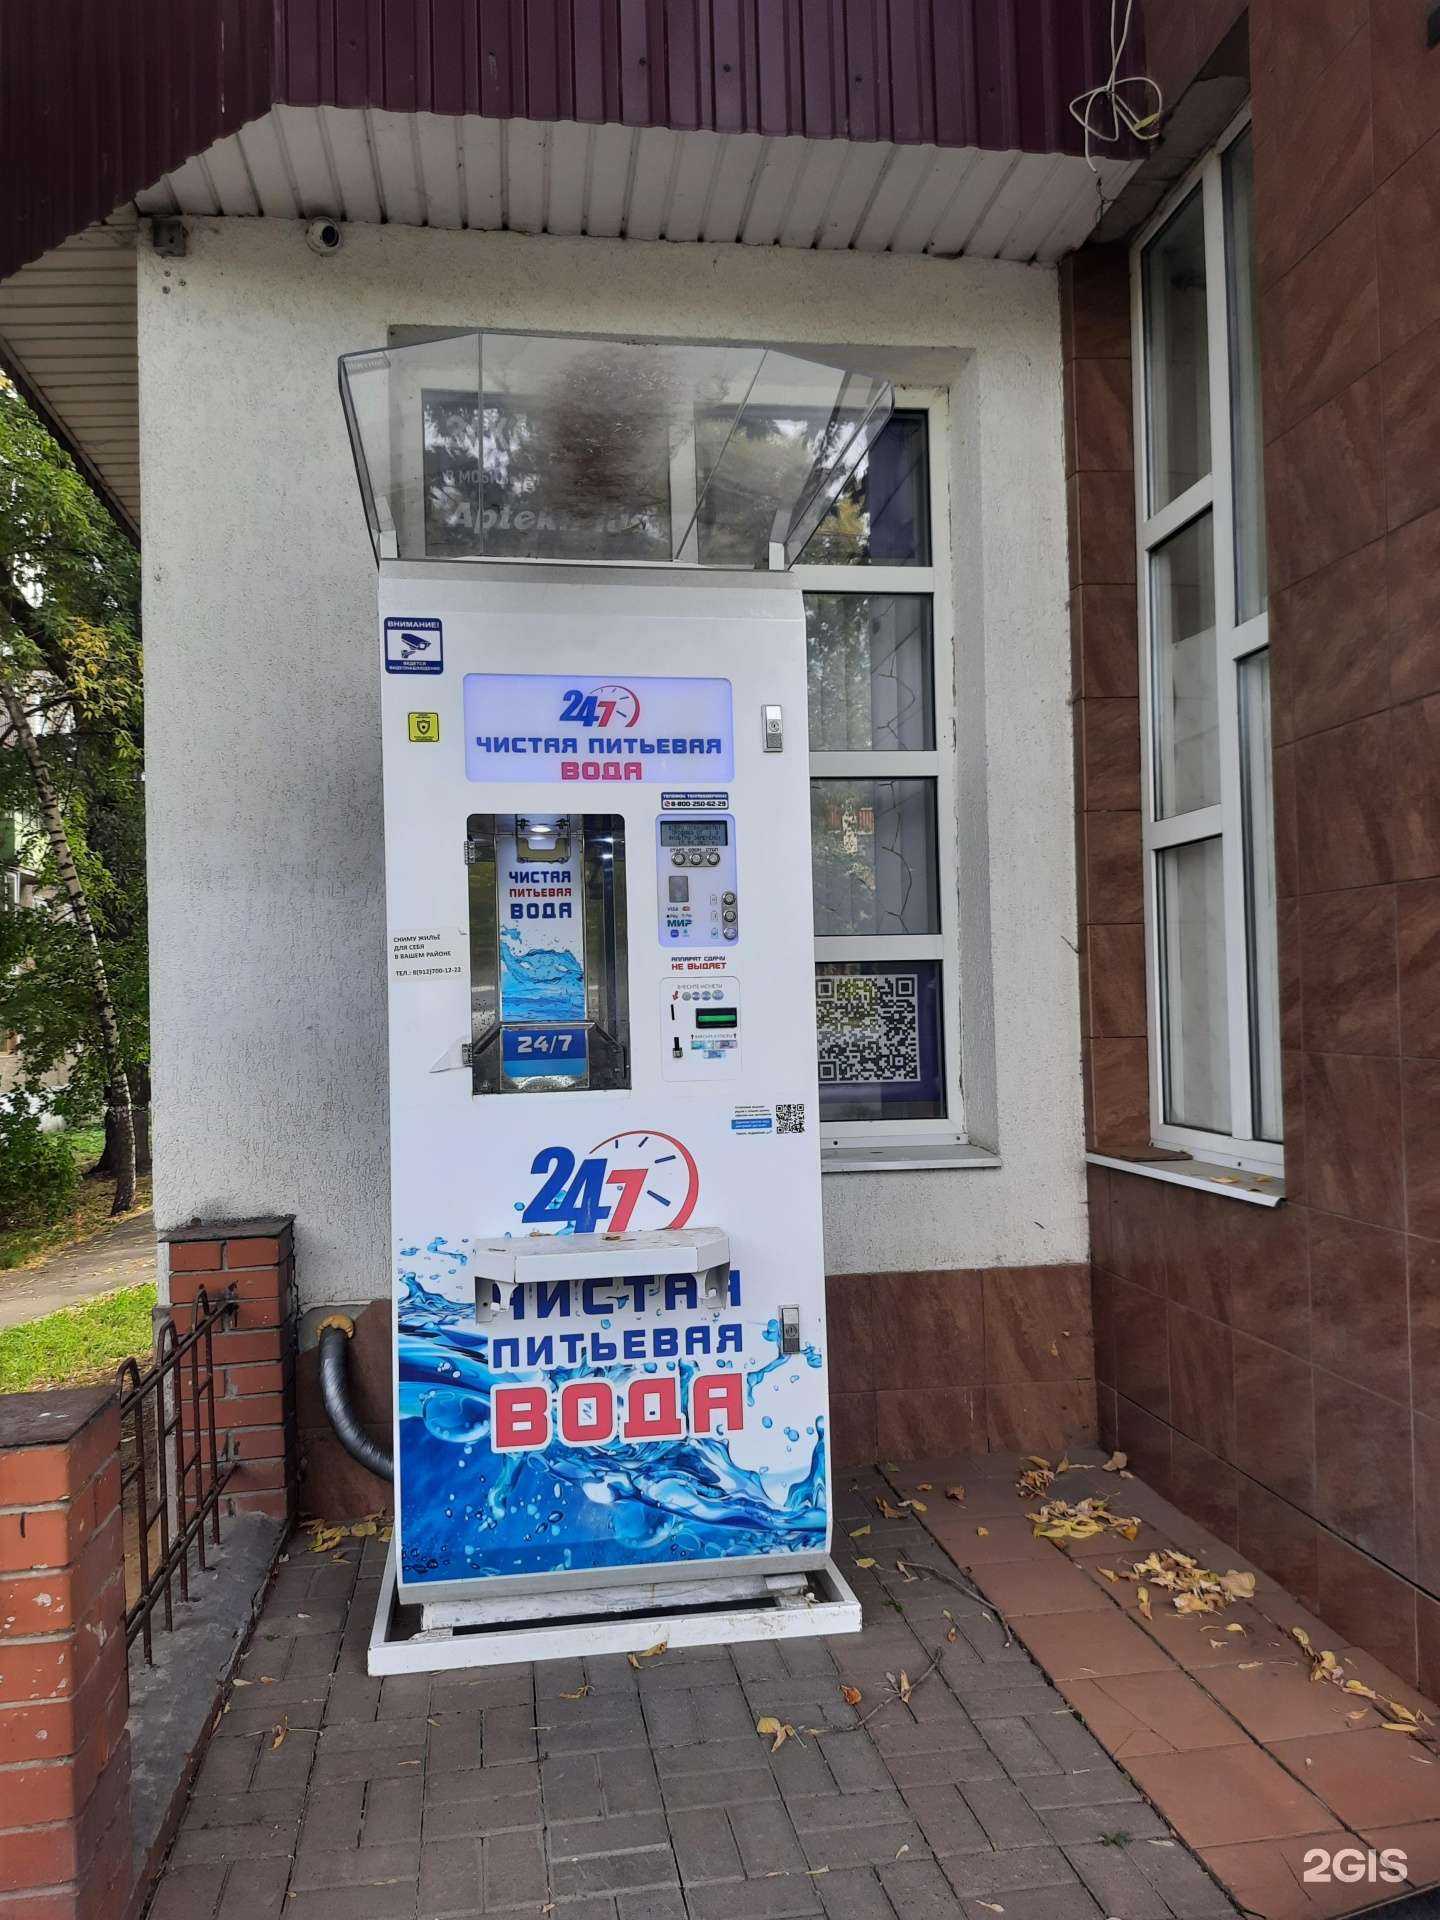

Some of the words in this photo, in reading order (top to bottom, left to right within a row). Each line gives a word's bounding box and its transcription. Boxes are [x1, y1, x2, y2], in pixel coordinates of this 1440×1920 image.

[387, 620, 440, 629] ВНИМАНИЕ!
[476, 736, 578, 754] ЧИСТАЯ
[588, 737, 722, 754] ПИТЬЕВАЯ
[561, 761, 643, 781] ВОДА
[509, 871, 571, 884] ЧИСТАЯ
[509, 887, 572, 897] ПИТЬЕВАЯ
[510, 902, 572, 920] ВОДА
[393, 935, 417, 943] СНИМУ
[400, 952, 425, 960] ВАШЕМ
[426, 950, 452, 958] РАЙОНЕ
[687, 962, 727, 970] ВЫДАЕТ
[517, 1034, 572, 1053] 24/7
[492, 1323, 743, 1369] ПИТЬЕВАЯ
[495, 1372, 744, 1449] ВОДА
